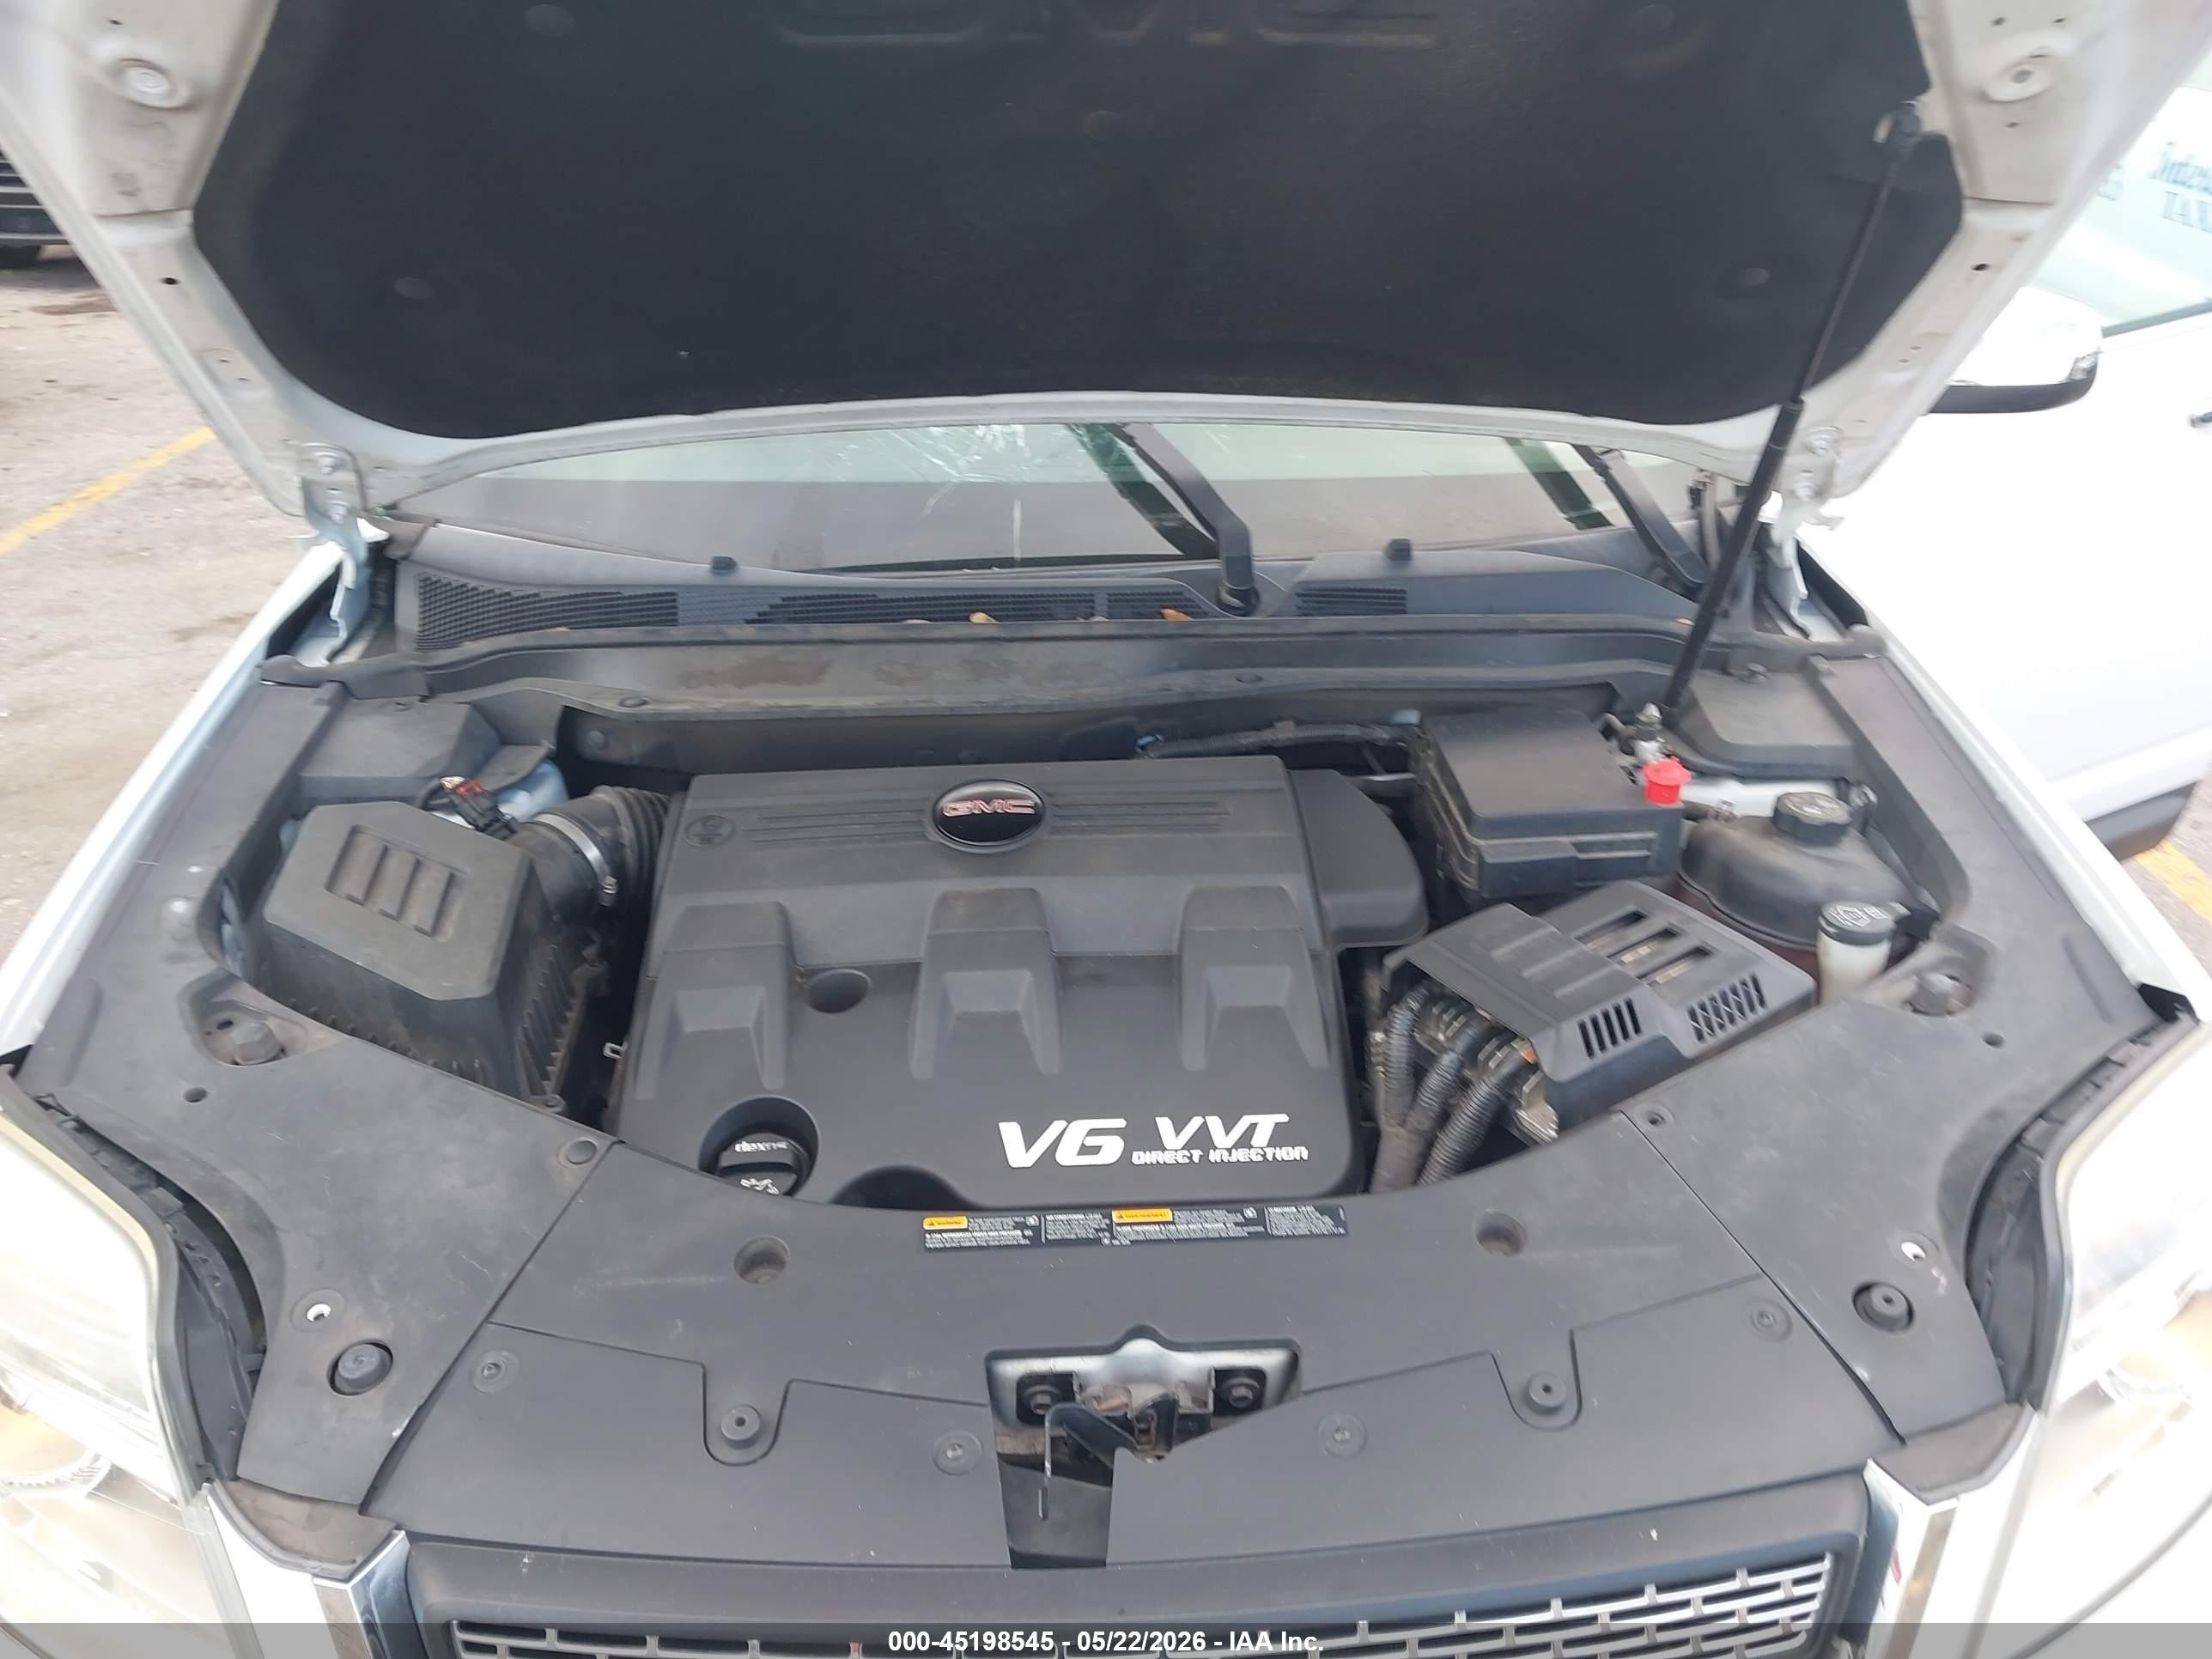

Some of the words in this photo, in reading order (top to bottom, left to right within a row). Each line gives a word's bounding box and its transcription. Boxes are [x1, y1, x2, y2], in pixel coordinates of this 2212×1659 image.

[943, 799, 1036, 817] GMC
[998, 1118, 1127, 1168] V6
[1155, 1114, 1289, 1150] VVT
[1131, 1150, 1204, 1165] DIRECT
[1208, 1146, 1309, 1164] INJECTION
